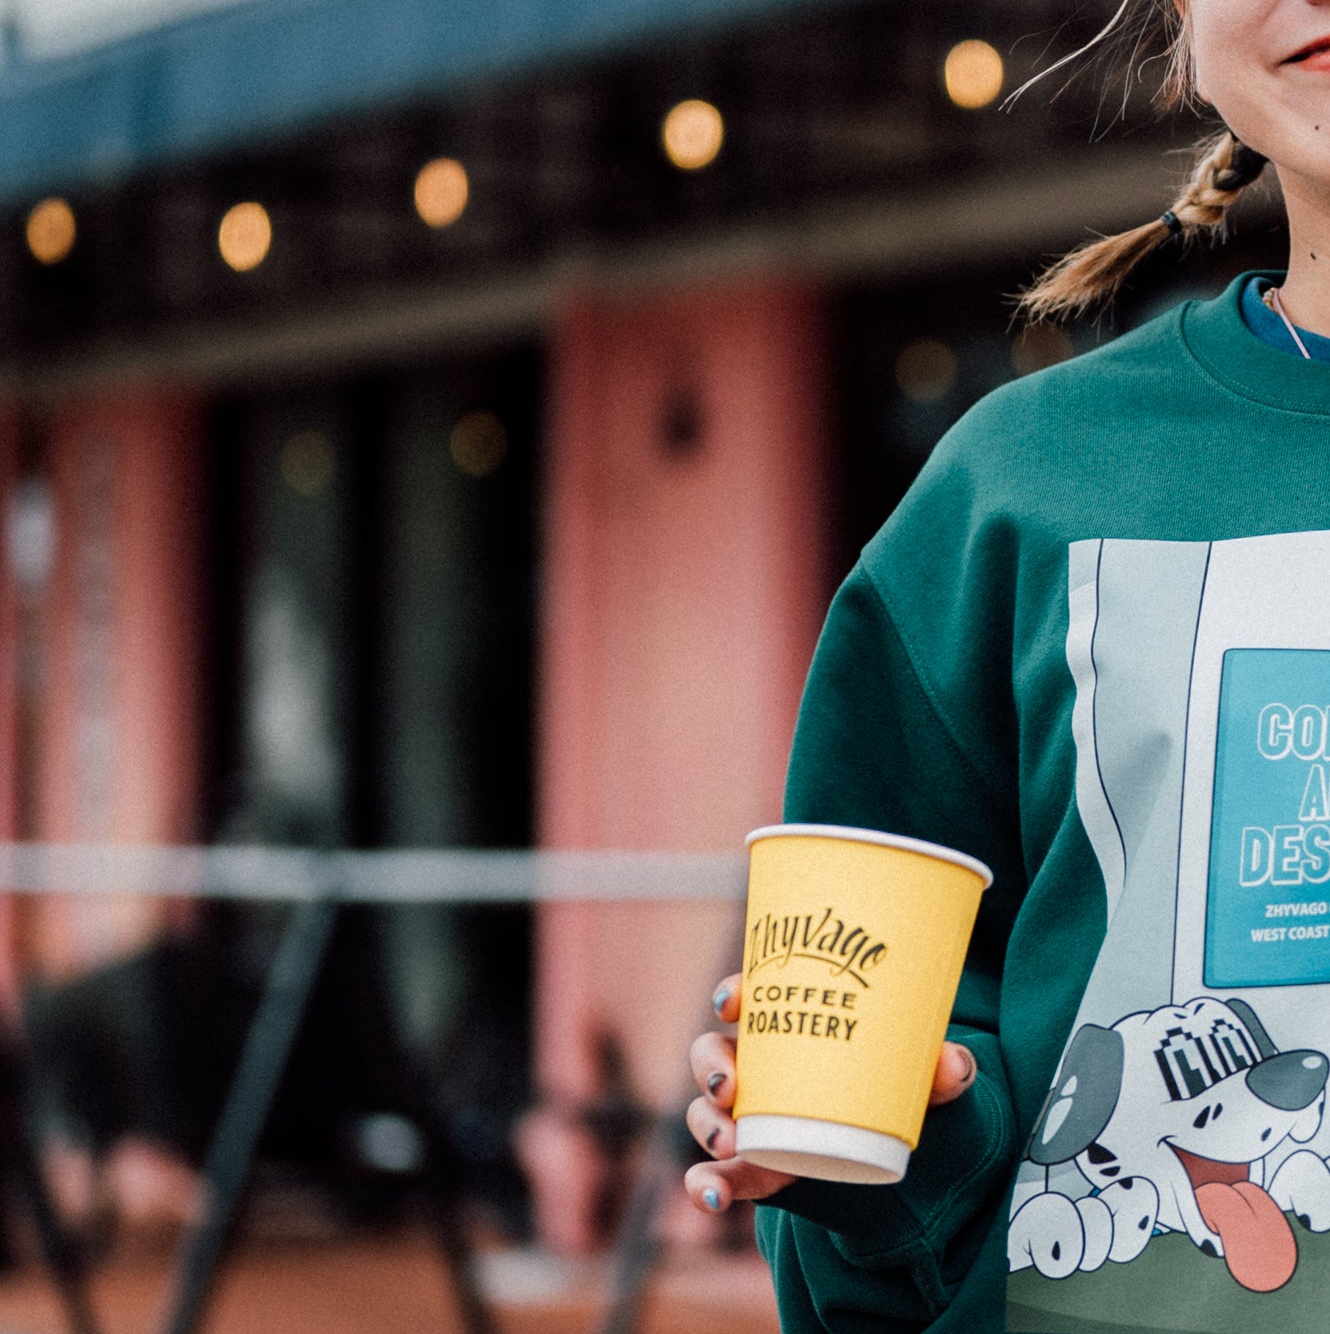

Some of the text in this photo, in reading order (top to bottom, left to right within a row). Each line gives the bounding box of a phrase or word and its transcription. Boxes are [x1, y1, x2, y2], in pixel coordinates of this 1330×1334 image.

[1265, 901, 1328, 918] ZHYVAGO
[1251, 928, 1287, 943] WEST
[1288, 924, 1330, 941] COAST
[753, 985, 857, 1010] COFFEE
[747, 1010, 858, 1041] ROASTERY
